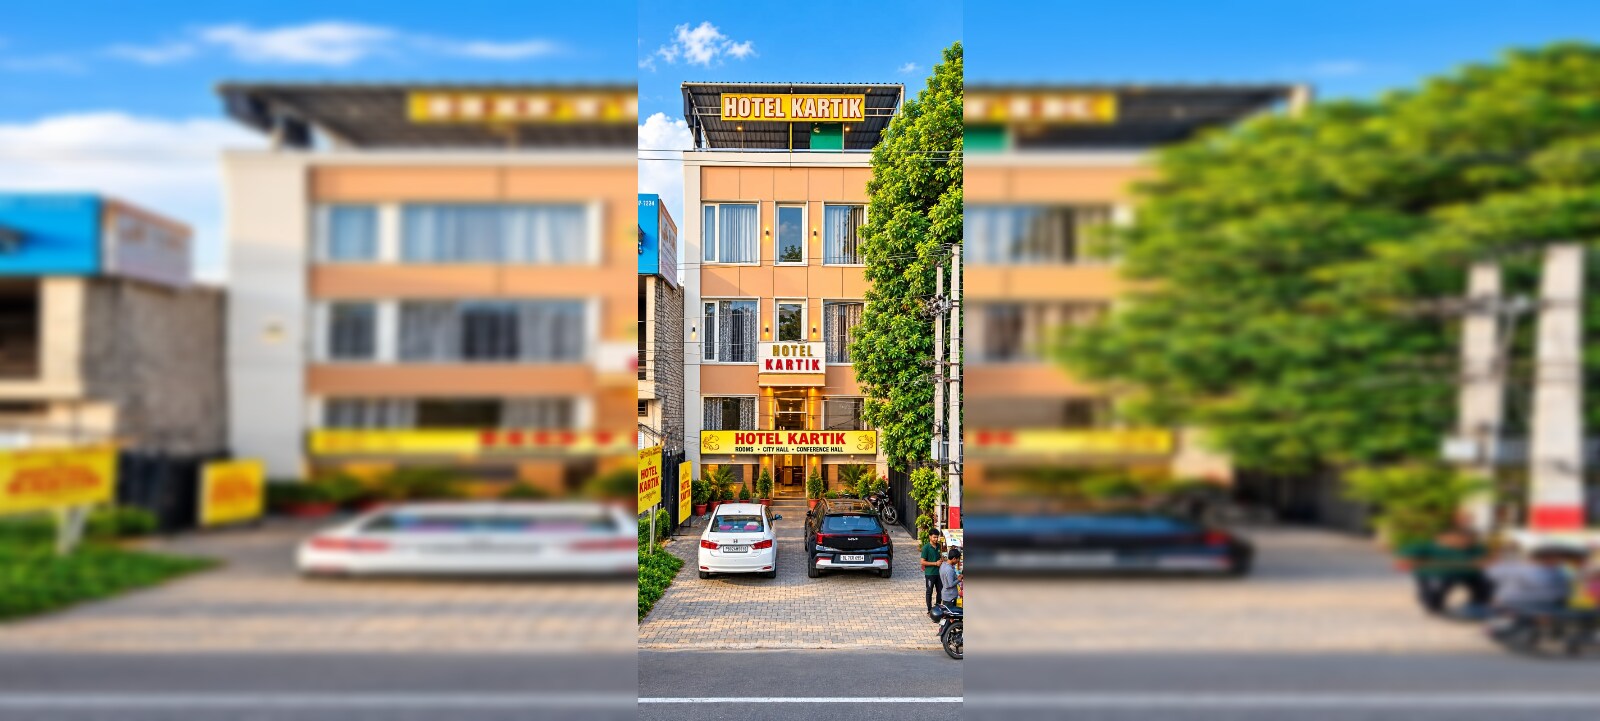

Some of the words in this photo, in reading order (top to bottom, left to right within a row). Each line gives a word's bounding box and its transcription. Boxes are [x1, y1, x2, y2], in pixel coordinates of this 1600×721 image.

[724, 97, 786, 118] HOTEL
[791, 97, 863, 118] KARTIK
[772, 345, 813, 356] HOTEL
[766, 359, 820, 370] KARTIK
[734, 433, 782, 445] HOTEL
[787, 433, 846, 444] KARTIK
[640, 466, 657, 480] HOTEL
[639, 476, 660, 494] KARTIK
